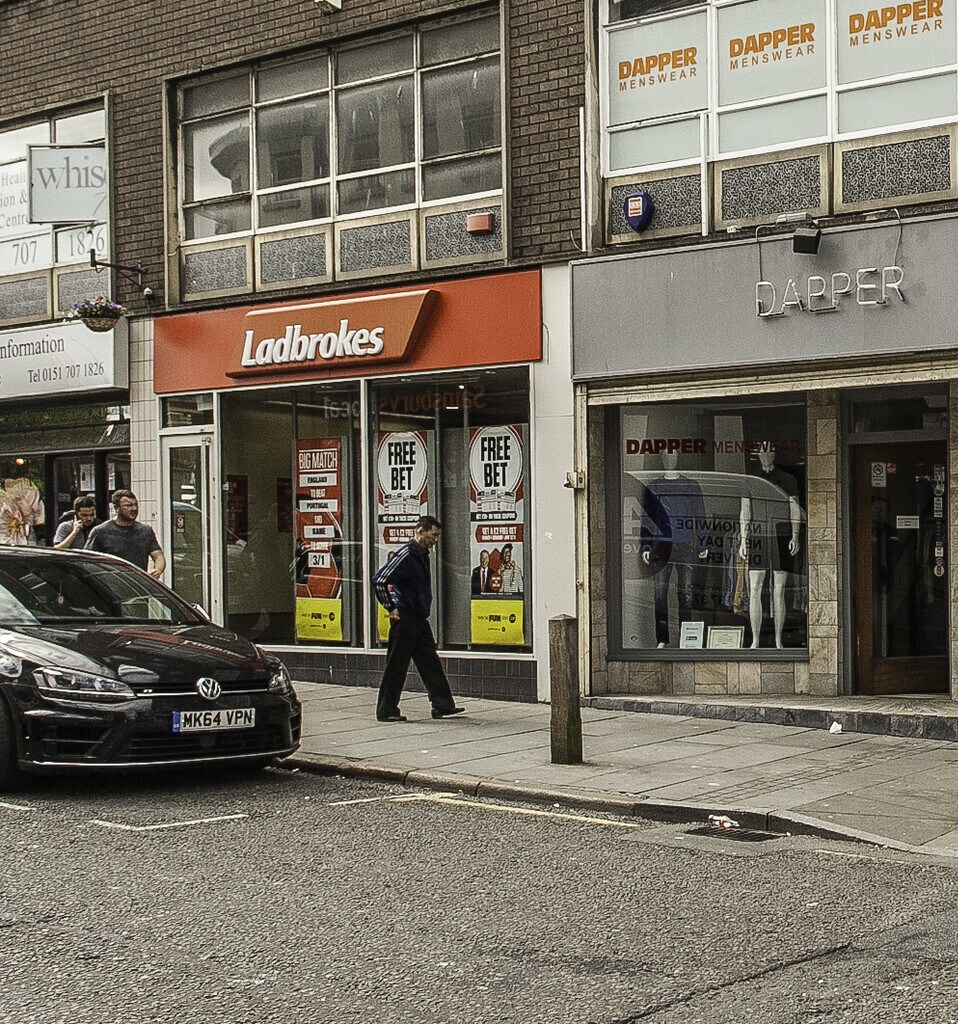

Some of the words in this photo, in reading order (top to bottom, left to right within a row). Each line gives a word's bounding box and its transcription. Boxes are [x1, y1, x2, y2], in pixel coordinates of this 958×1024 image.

[729, 22, 816, 59] DAPPER
[849, 19, 944, 47] MENSWEAR
[618, 46, 698, 80] DAPPER
[729, 44, 815, 71] MENSWEAR
[618, 66, 698, 92] MENSWEAR
[36, 155, 107, 190] whis
[11, 240, 38, 266] 707
[69, 228, 105, 257] 1826
[755, 266, 905, 317] DAPPER
[0, 334, 65, 359] nformation
[240, 319, 385, 368] Ladbrokes
[28, 369, 40, 383] Tel
[42, 366, 62, 382] 0151
[66, 364, 81, 379] 707
[84, 361, 104, 377] 1826
[388, 441, 416, 466] FREE
[480, 435, 511, 462] FREE
[626, 438, 707, 455] DAPPER
[712, 439, 801, 454] MENSWEAR
[299, 452, 311, 469] BIG
[312, 451, 338, 469] MATCH
[391, 466, 413, 491] BET
[483, 462, 508, 488] BET
[312, 554, 325, 566] 3/1
[182, 711, 222, 728] MK64
[226, 709, 253, 726] VPN
